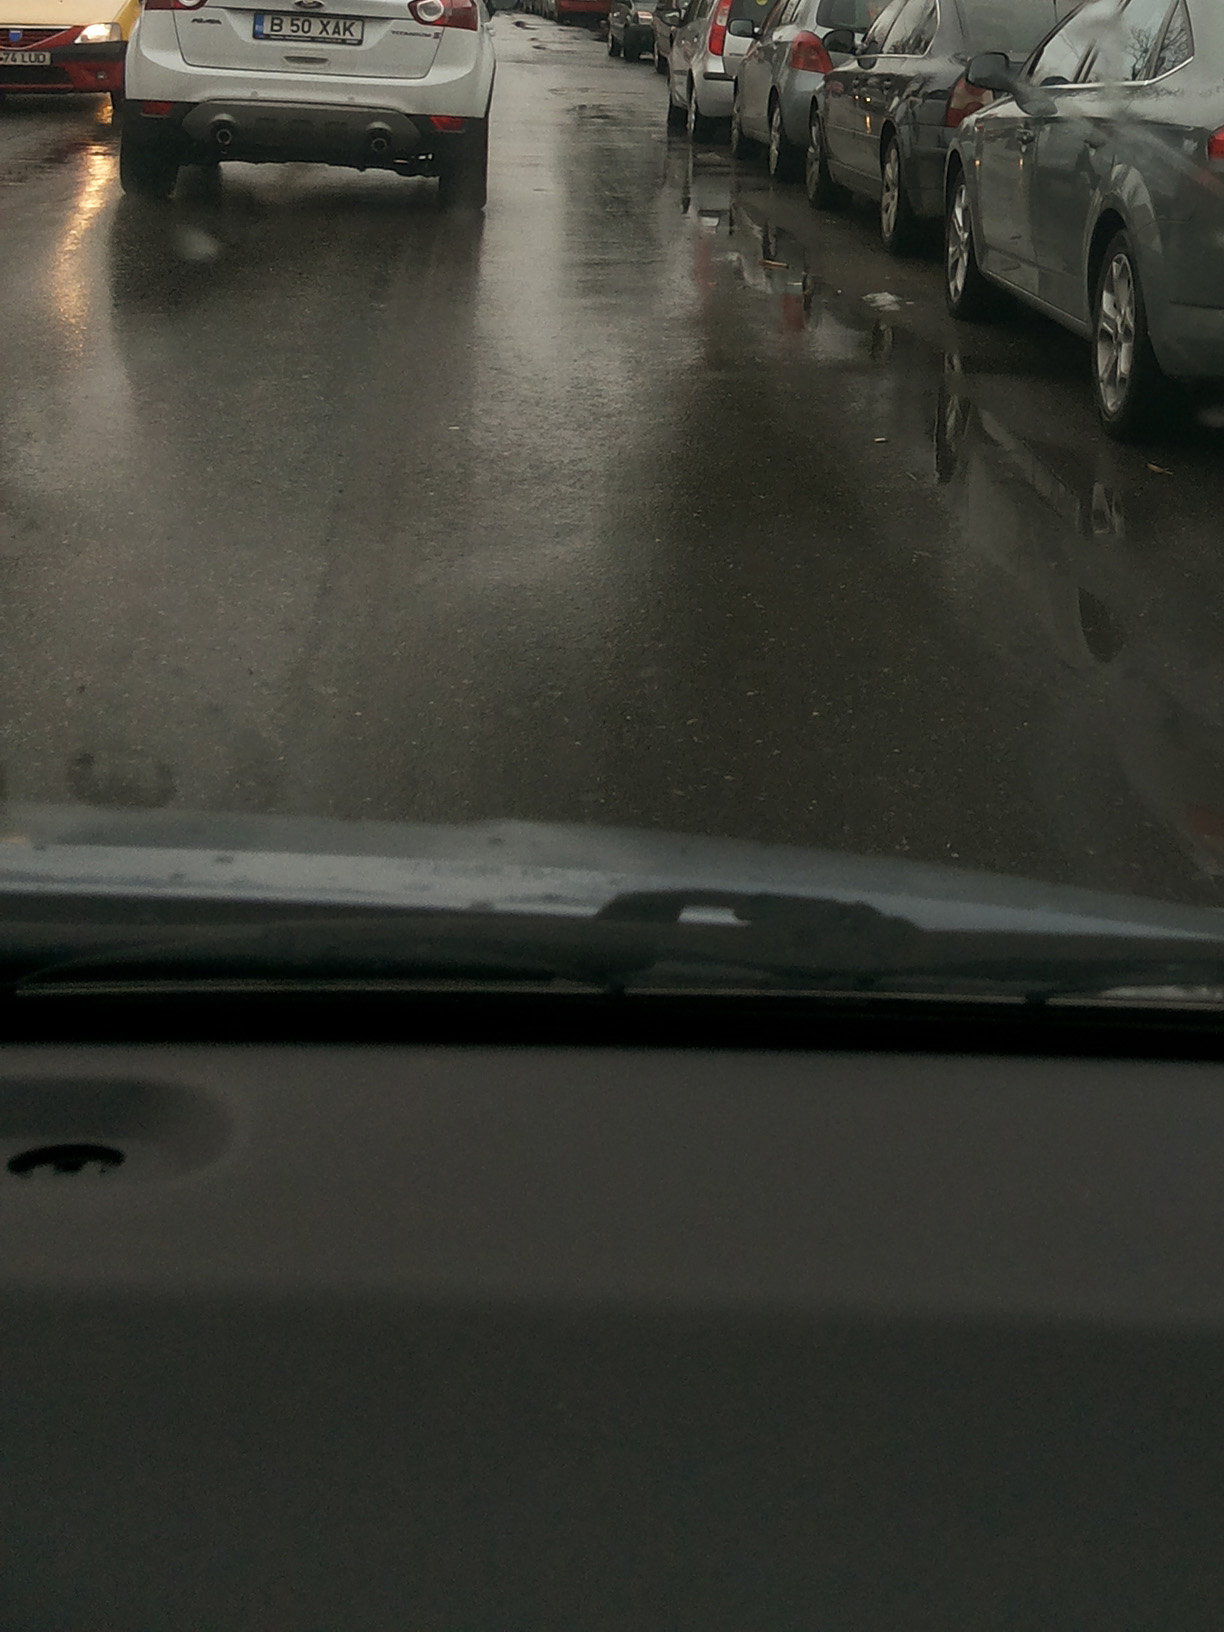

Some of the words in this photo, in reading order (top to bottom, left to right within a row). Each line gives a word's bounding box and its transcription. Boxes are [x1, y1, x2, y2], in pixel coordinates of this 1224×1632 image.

[270, 17, 283, 32] B
[290, 18, 312, 35] 50
[319, 20, 356, 38] XAK
